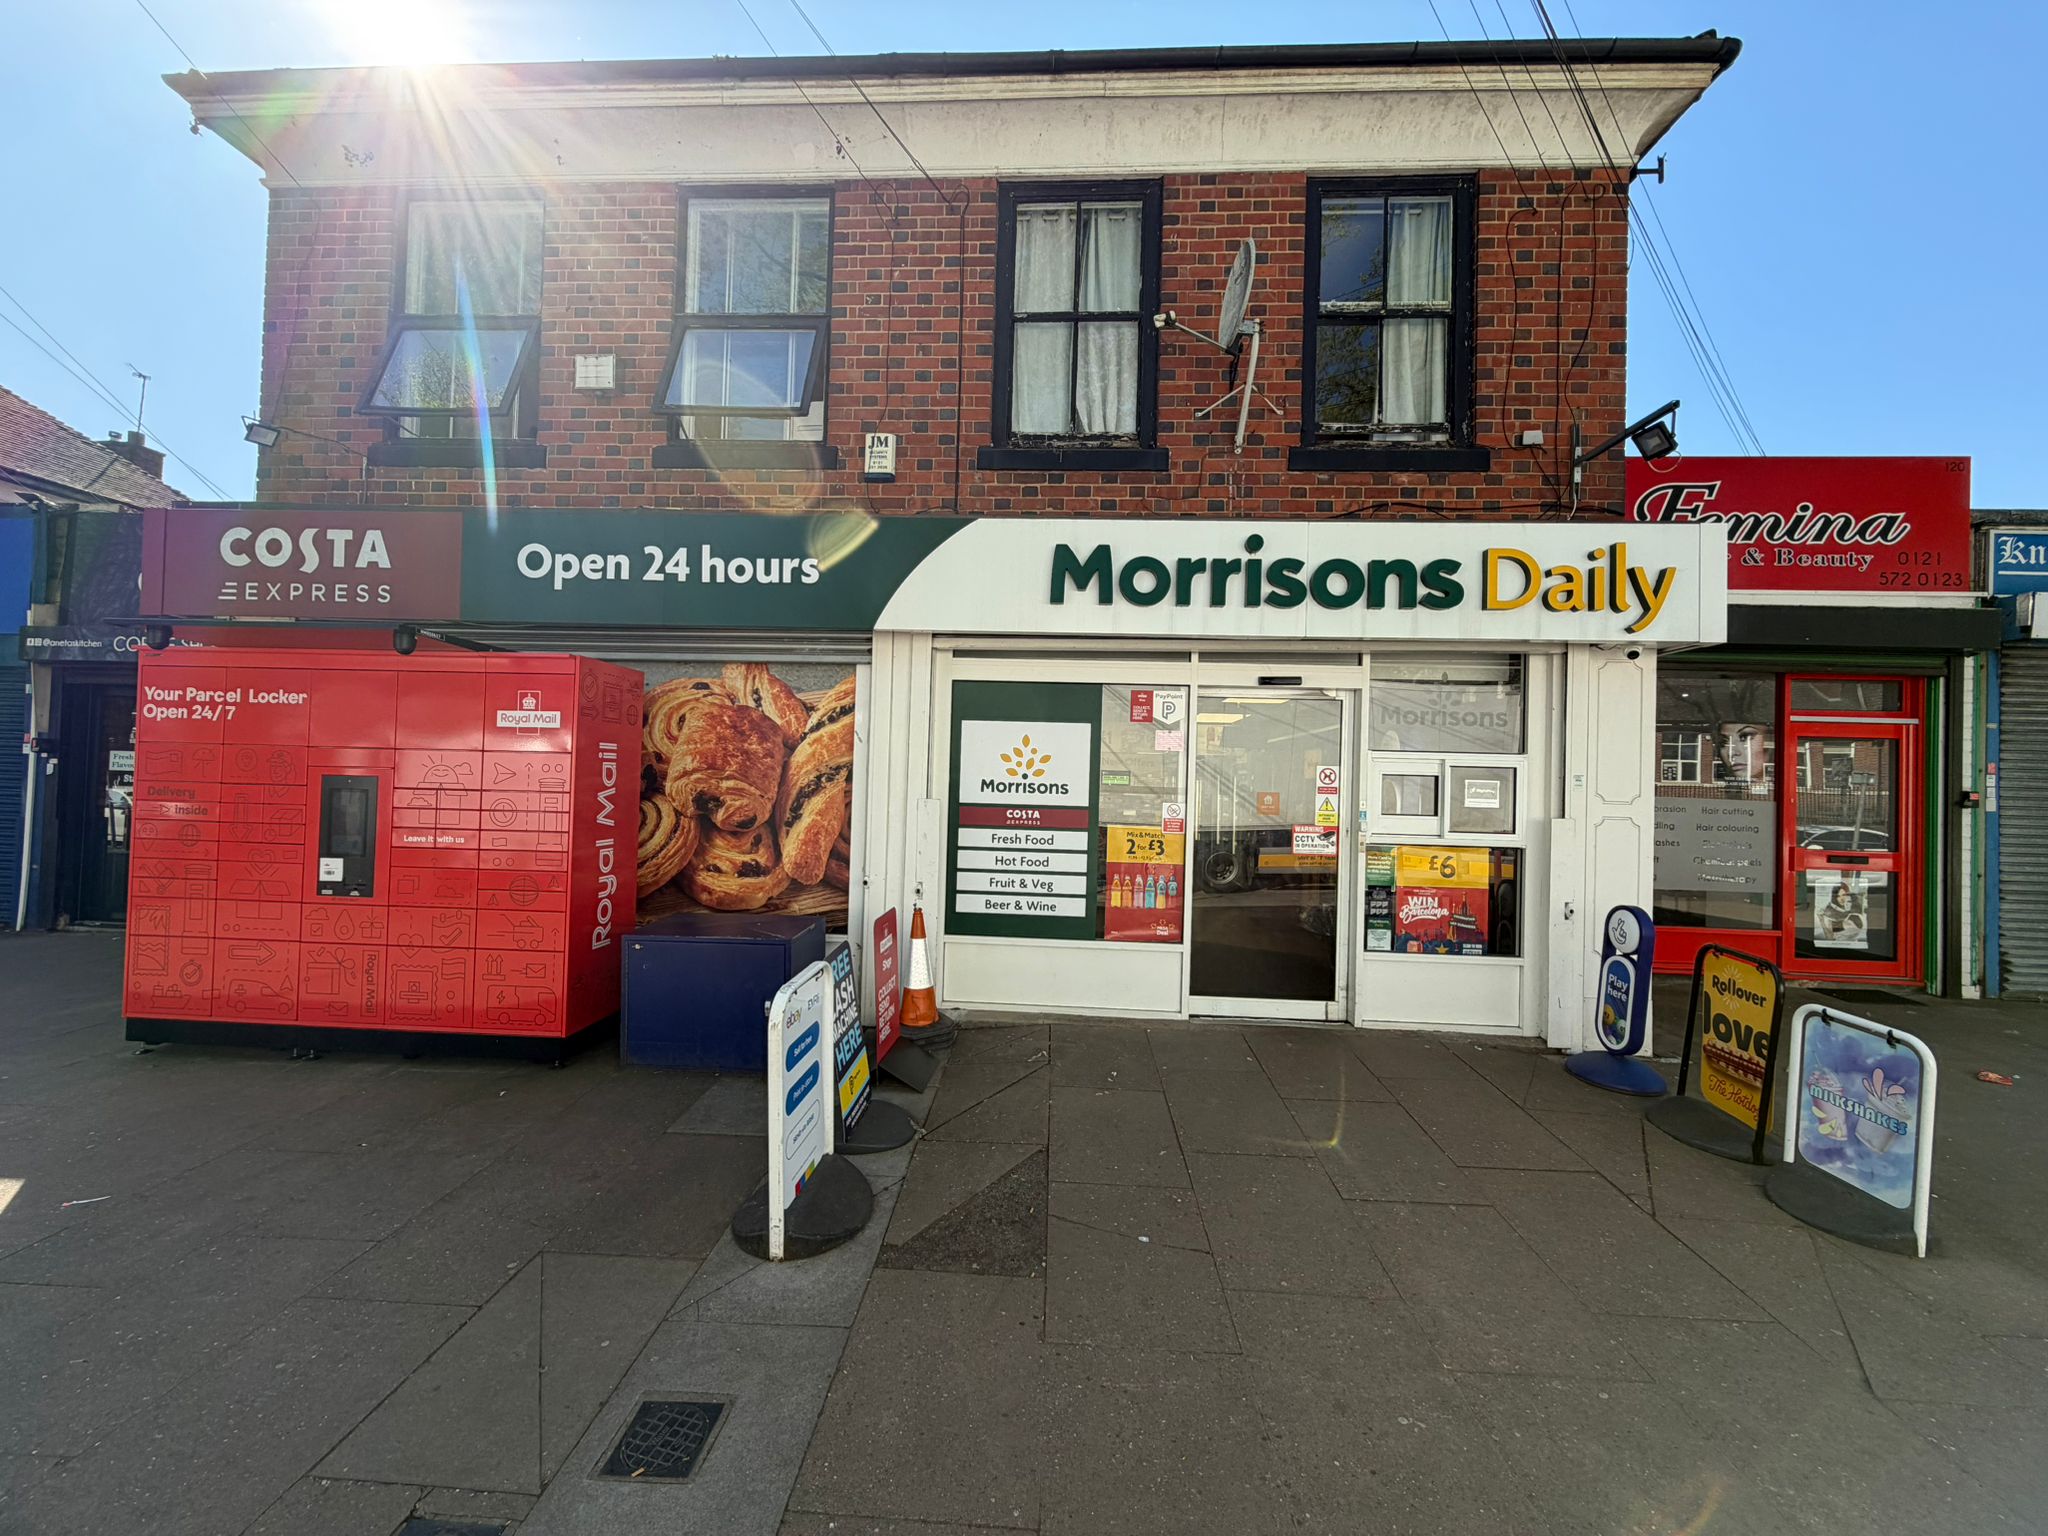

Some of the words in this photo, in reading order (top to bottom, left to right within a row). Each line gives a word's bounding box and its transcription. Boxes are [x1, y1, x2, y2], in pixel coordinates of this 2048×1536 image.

[868, 436, 889, 449] JM
[1945, 461, 1966, 473] 120
[1633, 481, 1911, 545] Fmina
[219, 527, 392, 574] COSTA
[1741, 547, 1765, 567] &
[1774, 548, 1874, 572] Beauty
[1897, 551, 1942, 566] 0121
[517, 543, 630, 590] Open
[642, 545, 690, 582] 24
[701, 544, 820, 584] hours
[1049, 533, 1466, 611] Morrisons
[1481, 542, 1677, 634] Daily
[1879, 571, 1911, 586] 572
[1919, 572, 1963, 587] 0123
[245, 582, 391, 603] EXPRESS
[144, 686, 183, 701] Your
[186, 687, 241, 703] Parcel
[248, 689, 307, 704] Locker
[143, 704, 188, 721] Open
[500, 712, 531, 724] Royal
[533, 712, 557, 723] Mail
[1380, 706, 1508, 728] Morrisons
[147, 786, 196, 799] Delivery
[597, 742, 618, 827] Mail
[980, 778, 1069, 795] Morrisons
[174, 804, 208, 815] inside
[1006, 809, 1040, 819] COSTA
[1702, 807, 1720, 815] Hair
[1722, 807, 1754, 816] cutting
[1294, 825, 1325, 833] WARNING
[1696, 824, 1714, 832] Hair
[1716, 824, 1759, 834] colouring
[403, 834, 425, 843] Leave
[427, 835, 434, 843] it
[436, 836, 453, 844] with
[991, 833, 1022, 845] Fresh
[1025, 835, 1054, 846] Food
[1126, 838, 1137, 855] 2
[1148, 839, 1166, 856] £3
[1295, 835, 1316, 843] CCTV
[995, 856, 1017, 867] Hot
[1020, 857, 1049, 868] Food
[1428, 855, 1456, 879] £6
[989, 877, 1016, 888] Fruit
[1019, 878, 1028, 889] &
[1031, 879, 1054, 892] Veg
[592, 838, 617, 950] Royal
[1407, 895, 1439, 908] WIN
[985, 899, 1011, 910] Beer
[1014, 900, 1023, 911] &
[1026, 901, 1057, 912] Wine
[1400, 905, 1450, 924] Barcelona
[364, 953, 377, 987] Royal
[832, 948, 850, 982] REE
[1608, 973, 1628, 992] Play
[1712, 974, 1767, 1008] Rollover
[364, 988, 376, 1014] Mail
[834, 974, 855, 1018] ASH
[1607, 985, 1627, 1002] here
[1704, 991, 1770, 1061] love
[836, 1020, 863, 1071] HERE
[1708, 1074, 1727, 1097] The
[1808, 1083, 1908, 1136] MILKSHAKES
